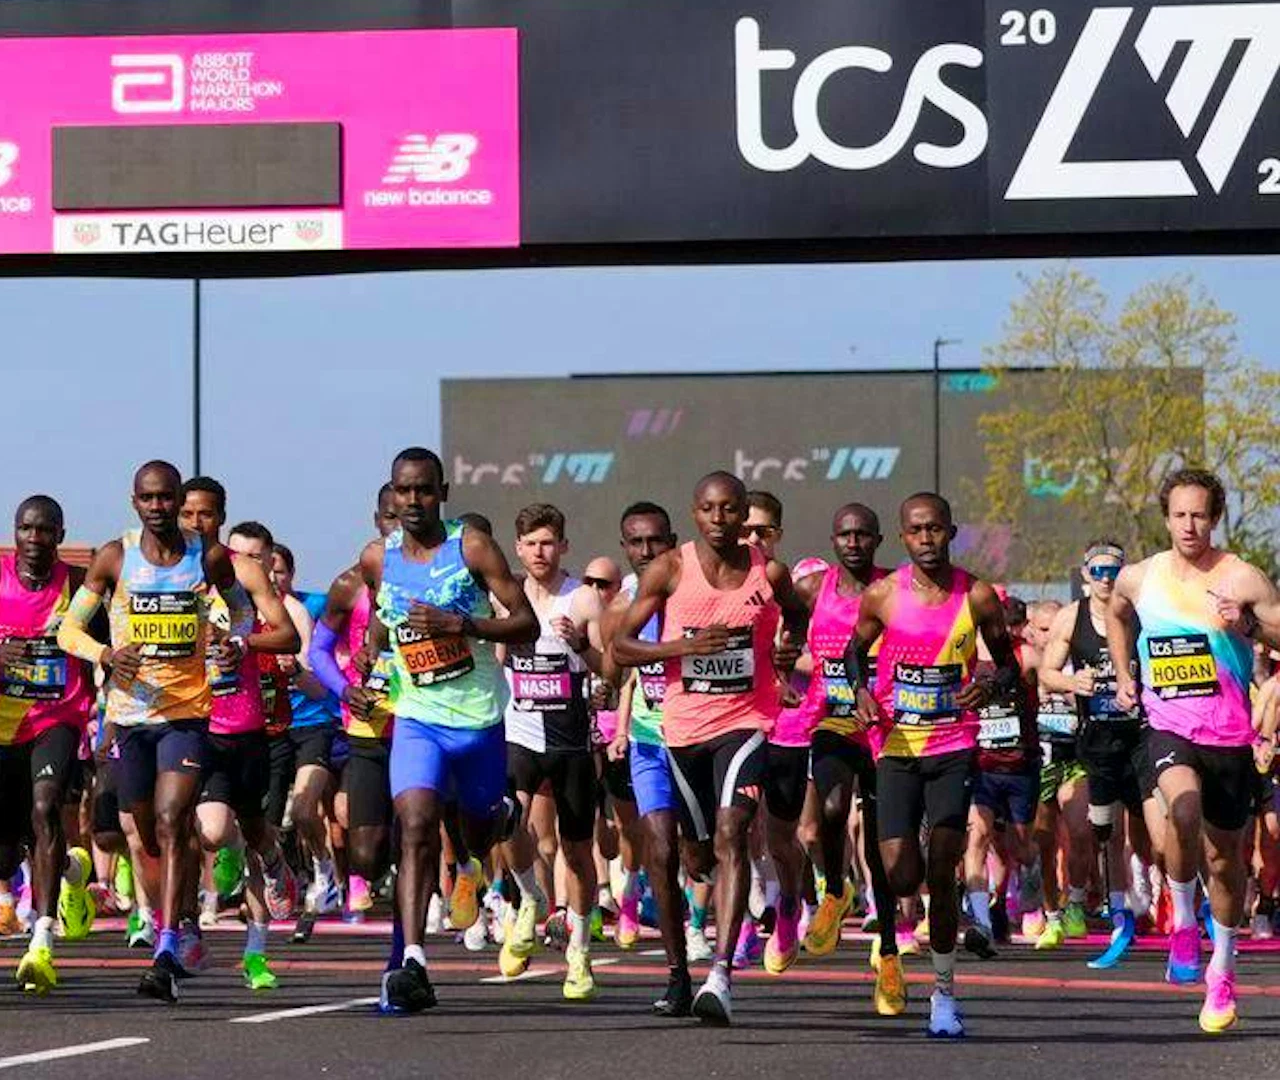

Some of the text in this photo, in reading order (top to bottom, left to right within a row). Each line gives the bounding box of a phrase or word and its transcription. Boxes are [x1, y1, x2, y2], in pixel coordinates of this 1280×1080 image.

[192, 52, 254, 67] ABBOTT
[191, 68, 250, 82] WORLD
[191, 81, 283, 97] MARATHON
[735, 10, 1056, 172] tcs 20
[190, 97, 255, 112] MAJORS
[1257, 158, 1280, 194] 2
[364, 187, 492, 206] new balance
[133, 595, 158, 612] tcs
[133, 622, 195, 639] KIPLIMO
[1150, 640, 1172, 655] tcs
[406, 644, 470, 670] GOBENA
[511, 655, 533, 671] tcs
[692, 658, 744, 675] SAWE
[824, 659, 846, 677] tcs
[897, 664, 922, 683] tcs
[1153, 663, 1212, 681] HOGAN
[519, 679, 562, 696] NASH
[898, 688, 938, 709] PACE
